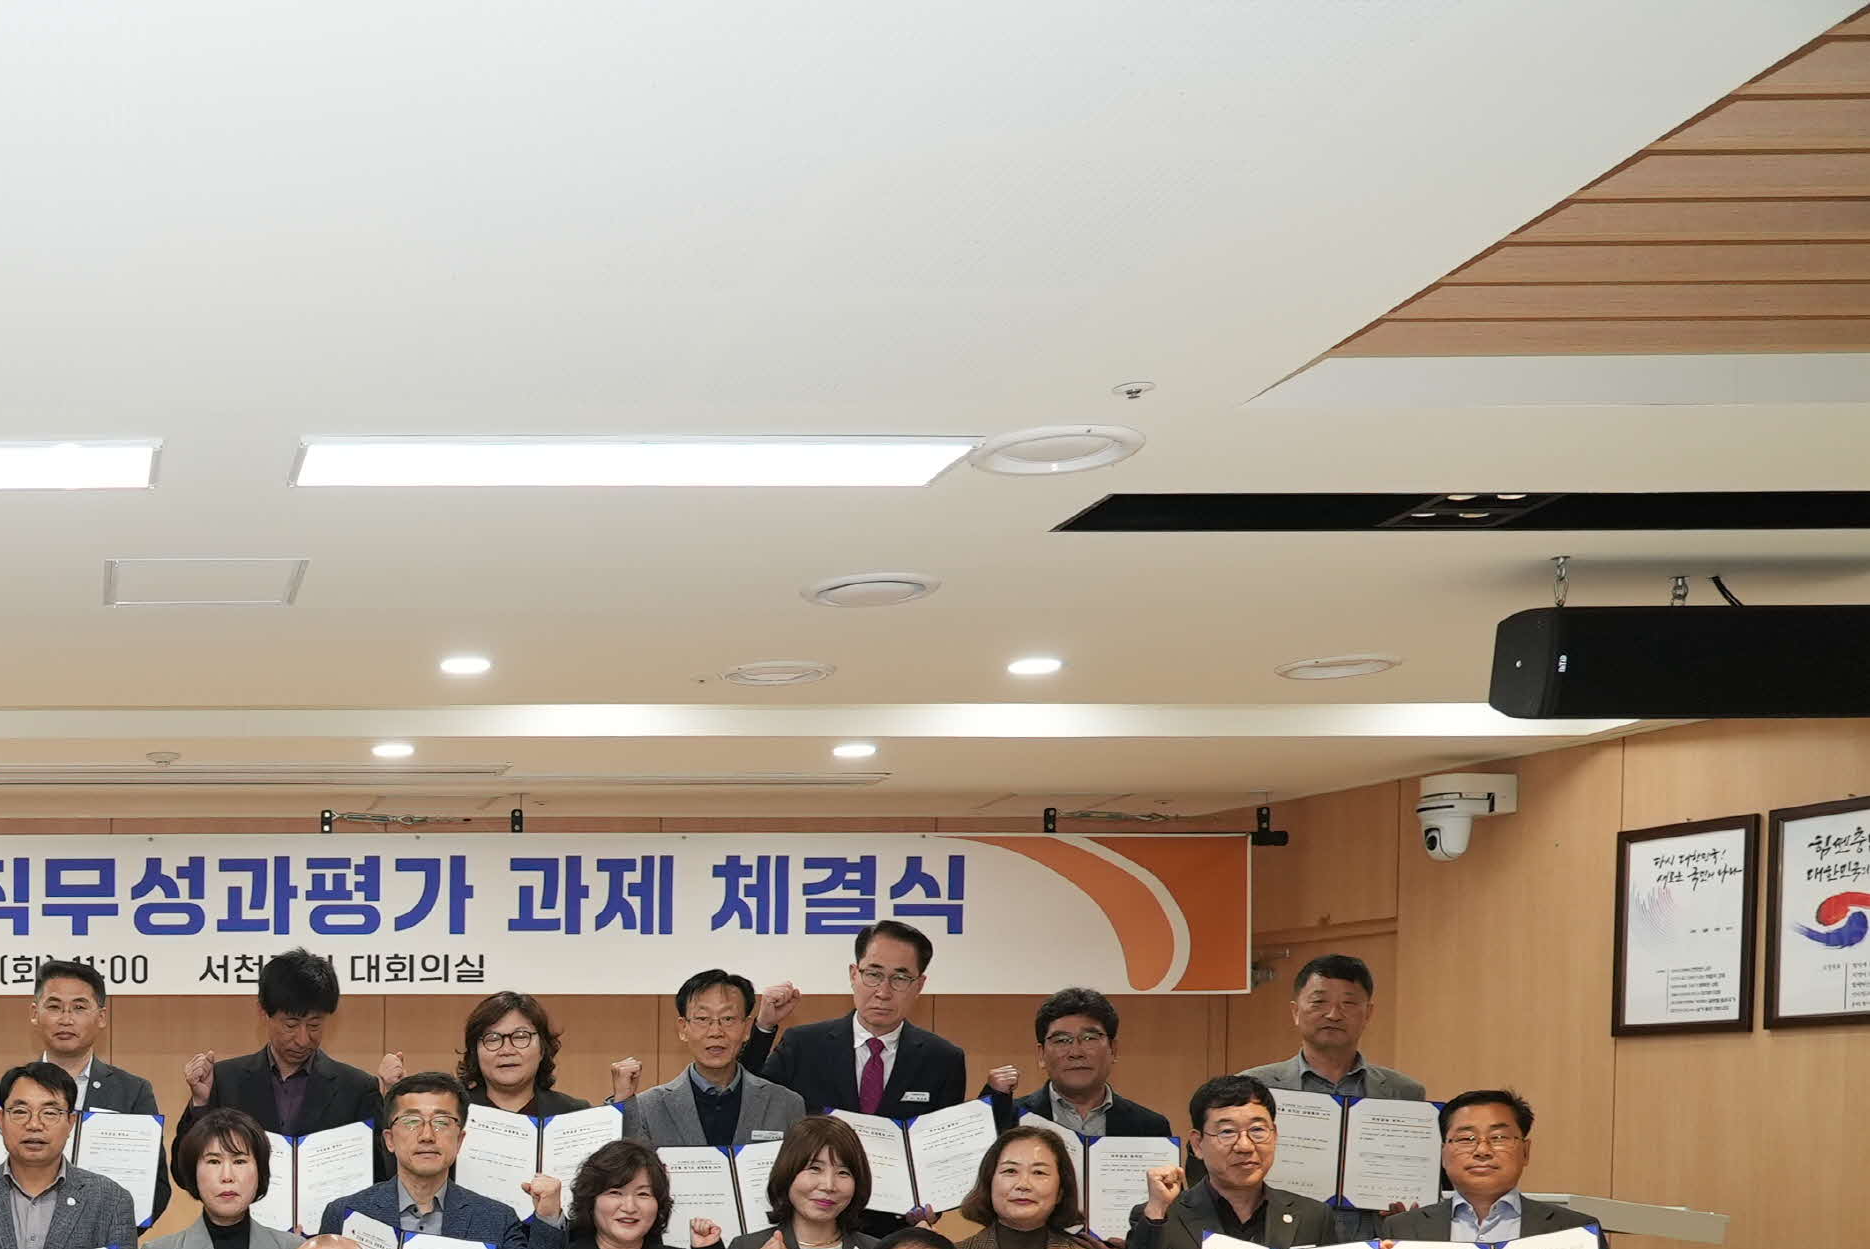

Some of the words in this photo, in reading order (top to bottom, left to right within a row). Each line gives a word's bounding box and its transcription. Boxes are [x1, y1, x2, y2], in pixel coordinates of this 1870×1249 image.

[1807, 826, 1870, 861] 힘쎈충
[507, 856, 674, 935] 과제
[710, 855, 965, 935] 체결식
[72, 954, 149, 985] :00
[198, 953, 334, 984] 서천
[349, 952, 486, 984] 대회의실
